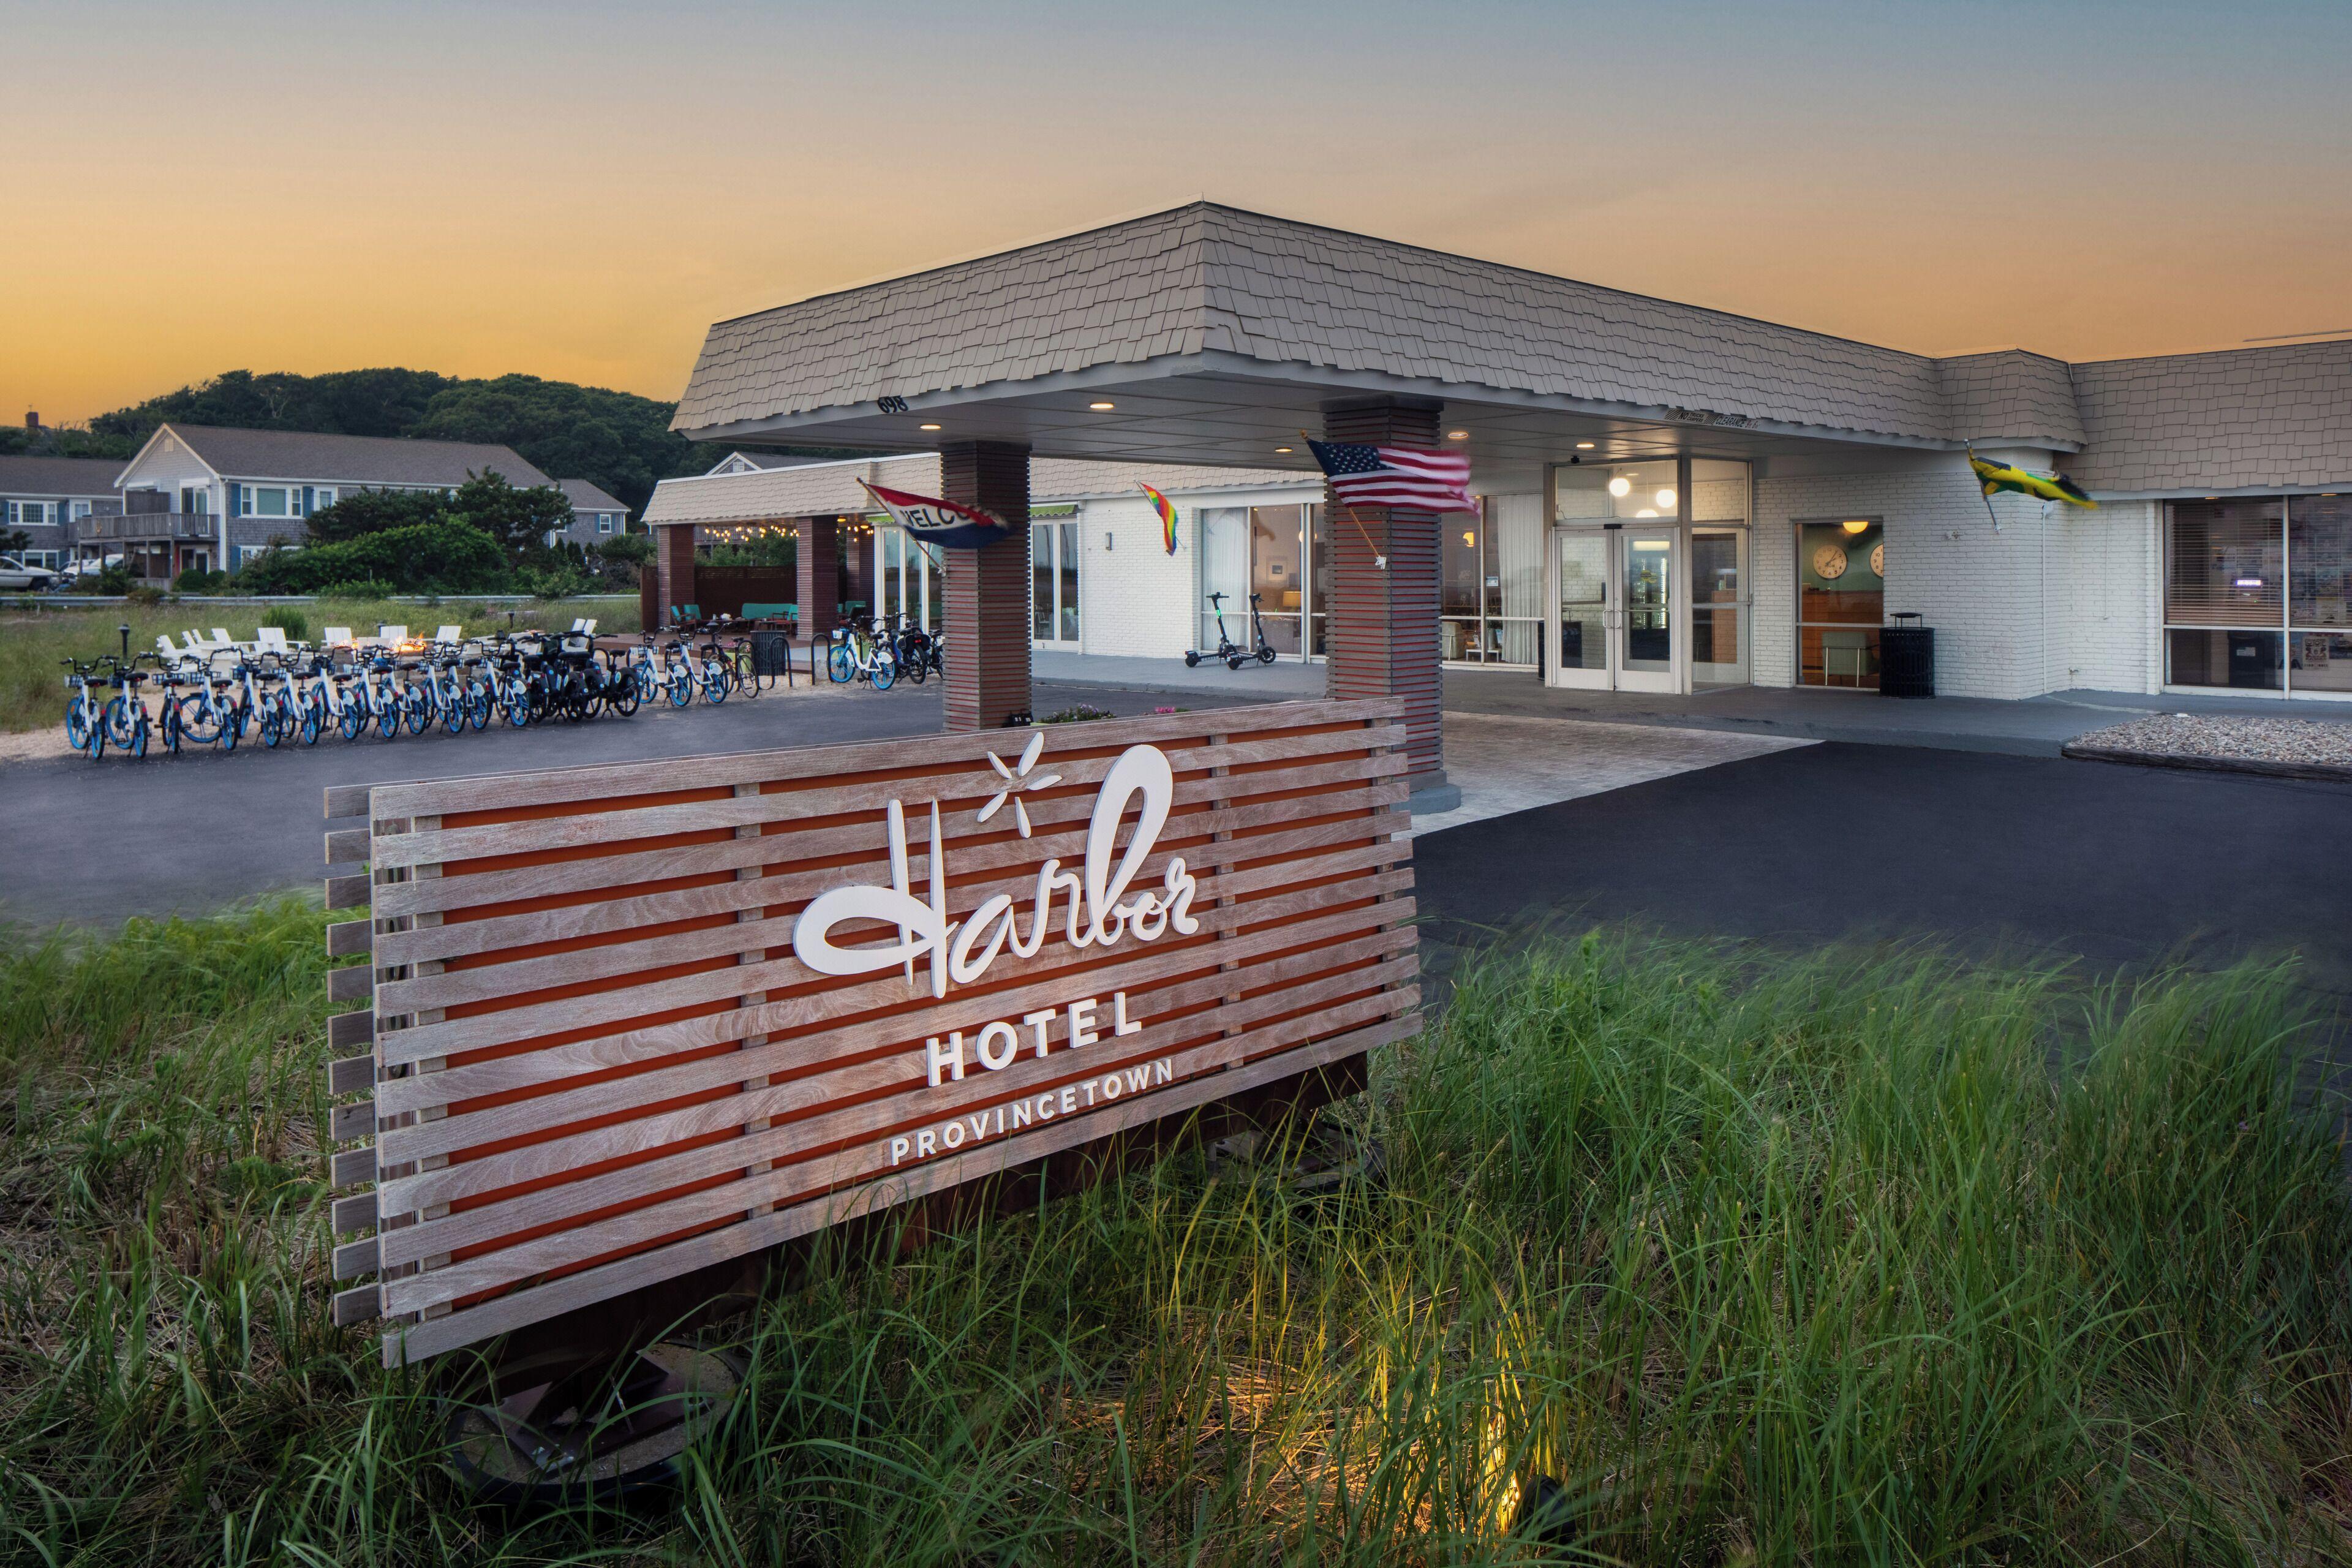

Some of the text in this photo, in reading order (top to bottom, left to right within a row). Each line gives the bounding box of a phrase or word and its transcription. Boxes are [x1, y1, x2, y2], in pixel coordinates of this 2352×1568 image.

[877, 395, 908, 413] 698
[1715, 416, 1747, 428] CLEARANCE
[793, 744, 1199, 998] Harbor
[926, 992, 1142, 1087] HOTEL
[891, 1058, 1172, 1166] PROVINCETOWN
